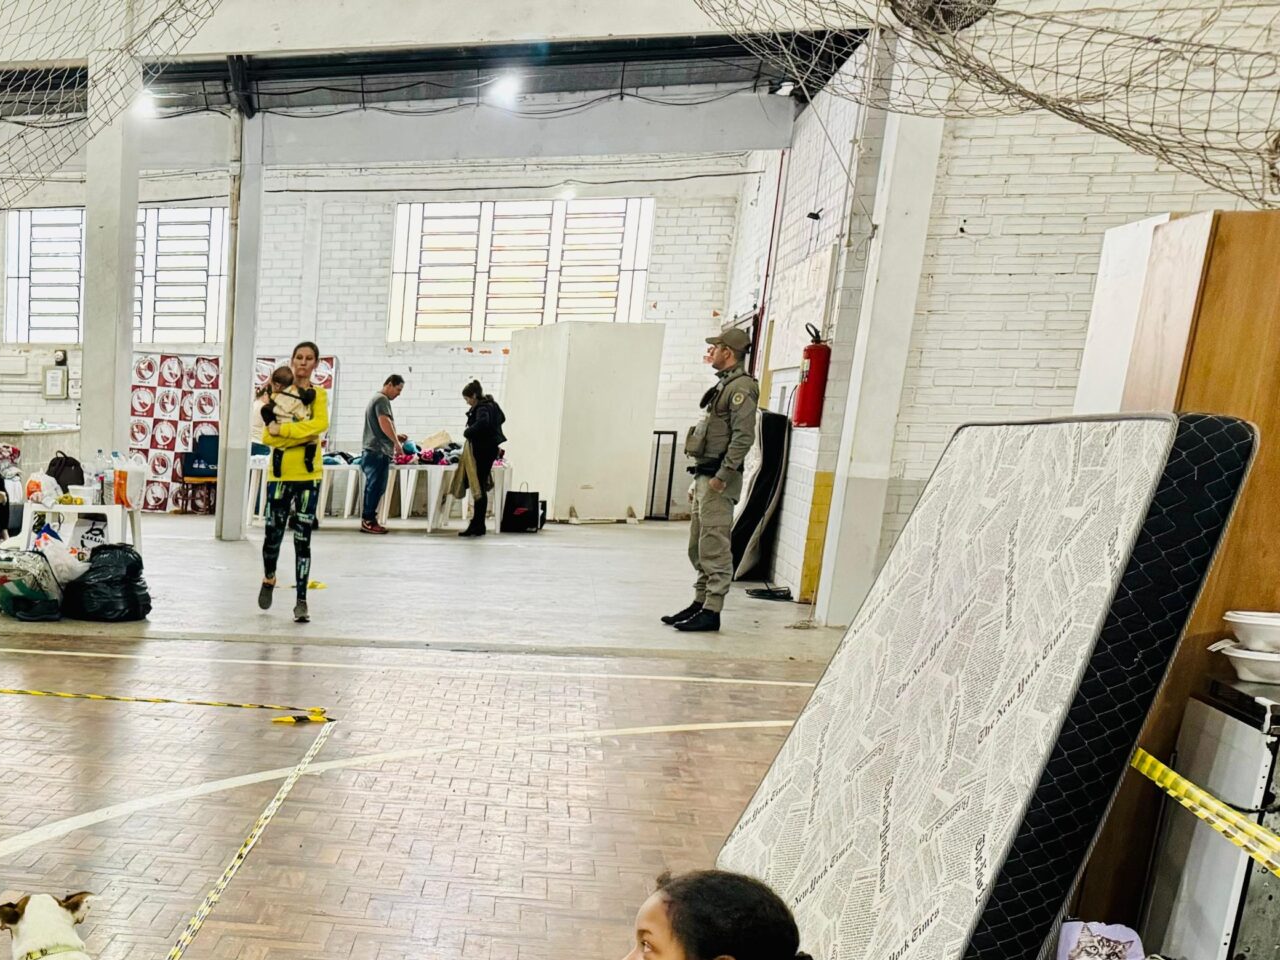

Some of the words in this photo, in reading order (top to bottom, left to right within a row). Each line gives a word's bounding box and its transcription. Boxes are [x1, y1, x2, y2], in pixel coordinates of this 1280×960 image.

[978, 722, 995, 745] The
[994, 695, 1014, 722] New
[1014, 661, 1041, 699] York
[1042, 616, 1072, 660] Times
